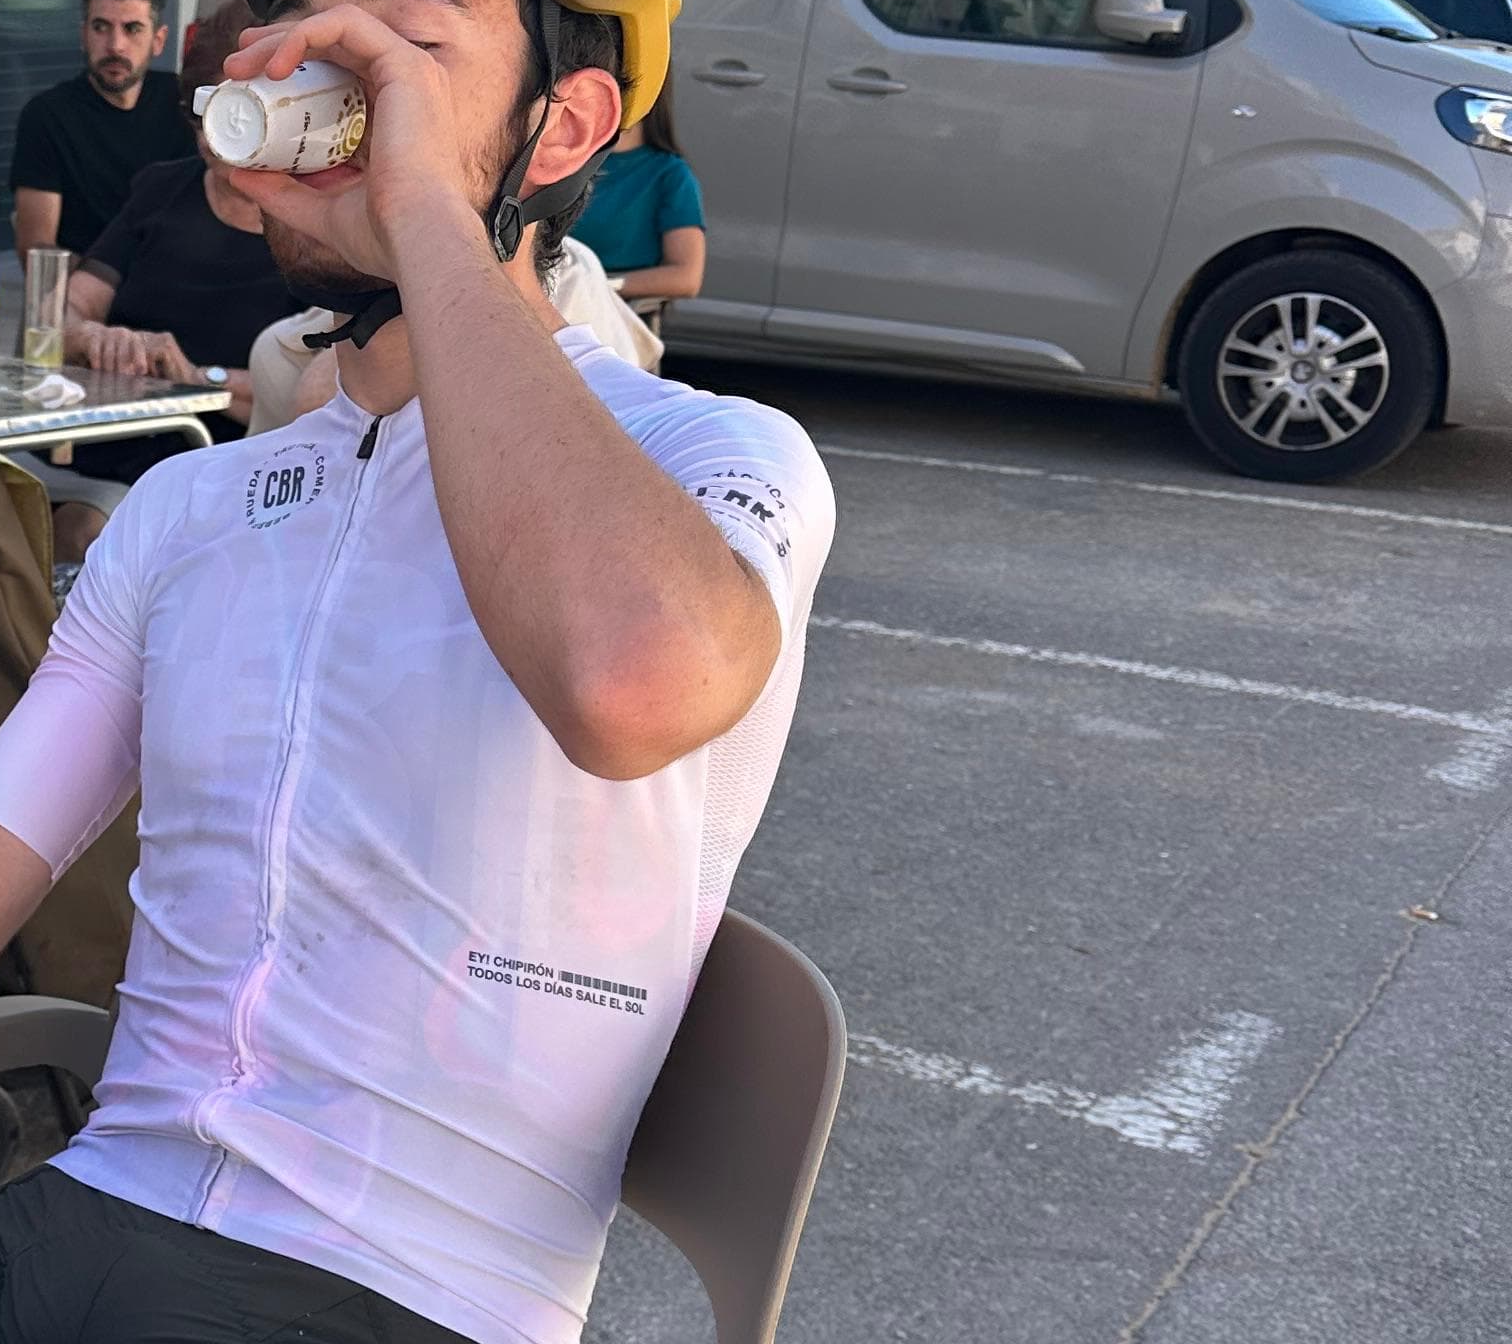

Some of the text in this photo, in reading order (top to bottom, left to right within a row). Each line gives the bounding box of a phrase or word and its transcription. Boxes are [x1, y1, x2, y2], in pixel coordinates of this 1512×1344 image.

[246, 469, 263, 518] RUEDA
[263, 465, 306, 509] CBR
[493, 955, 554, 979] CHIPIRÓN
[467, 965, 646, 1016] TODOS LOS DÍAS SALE EL SOL
